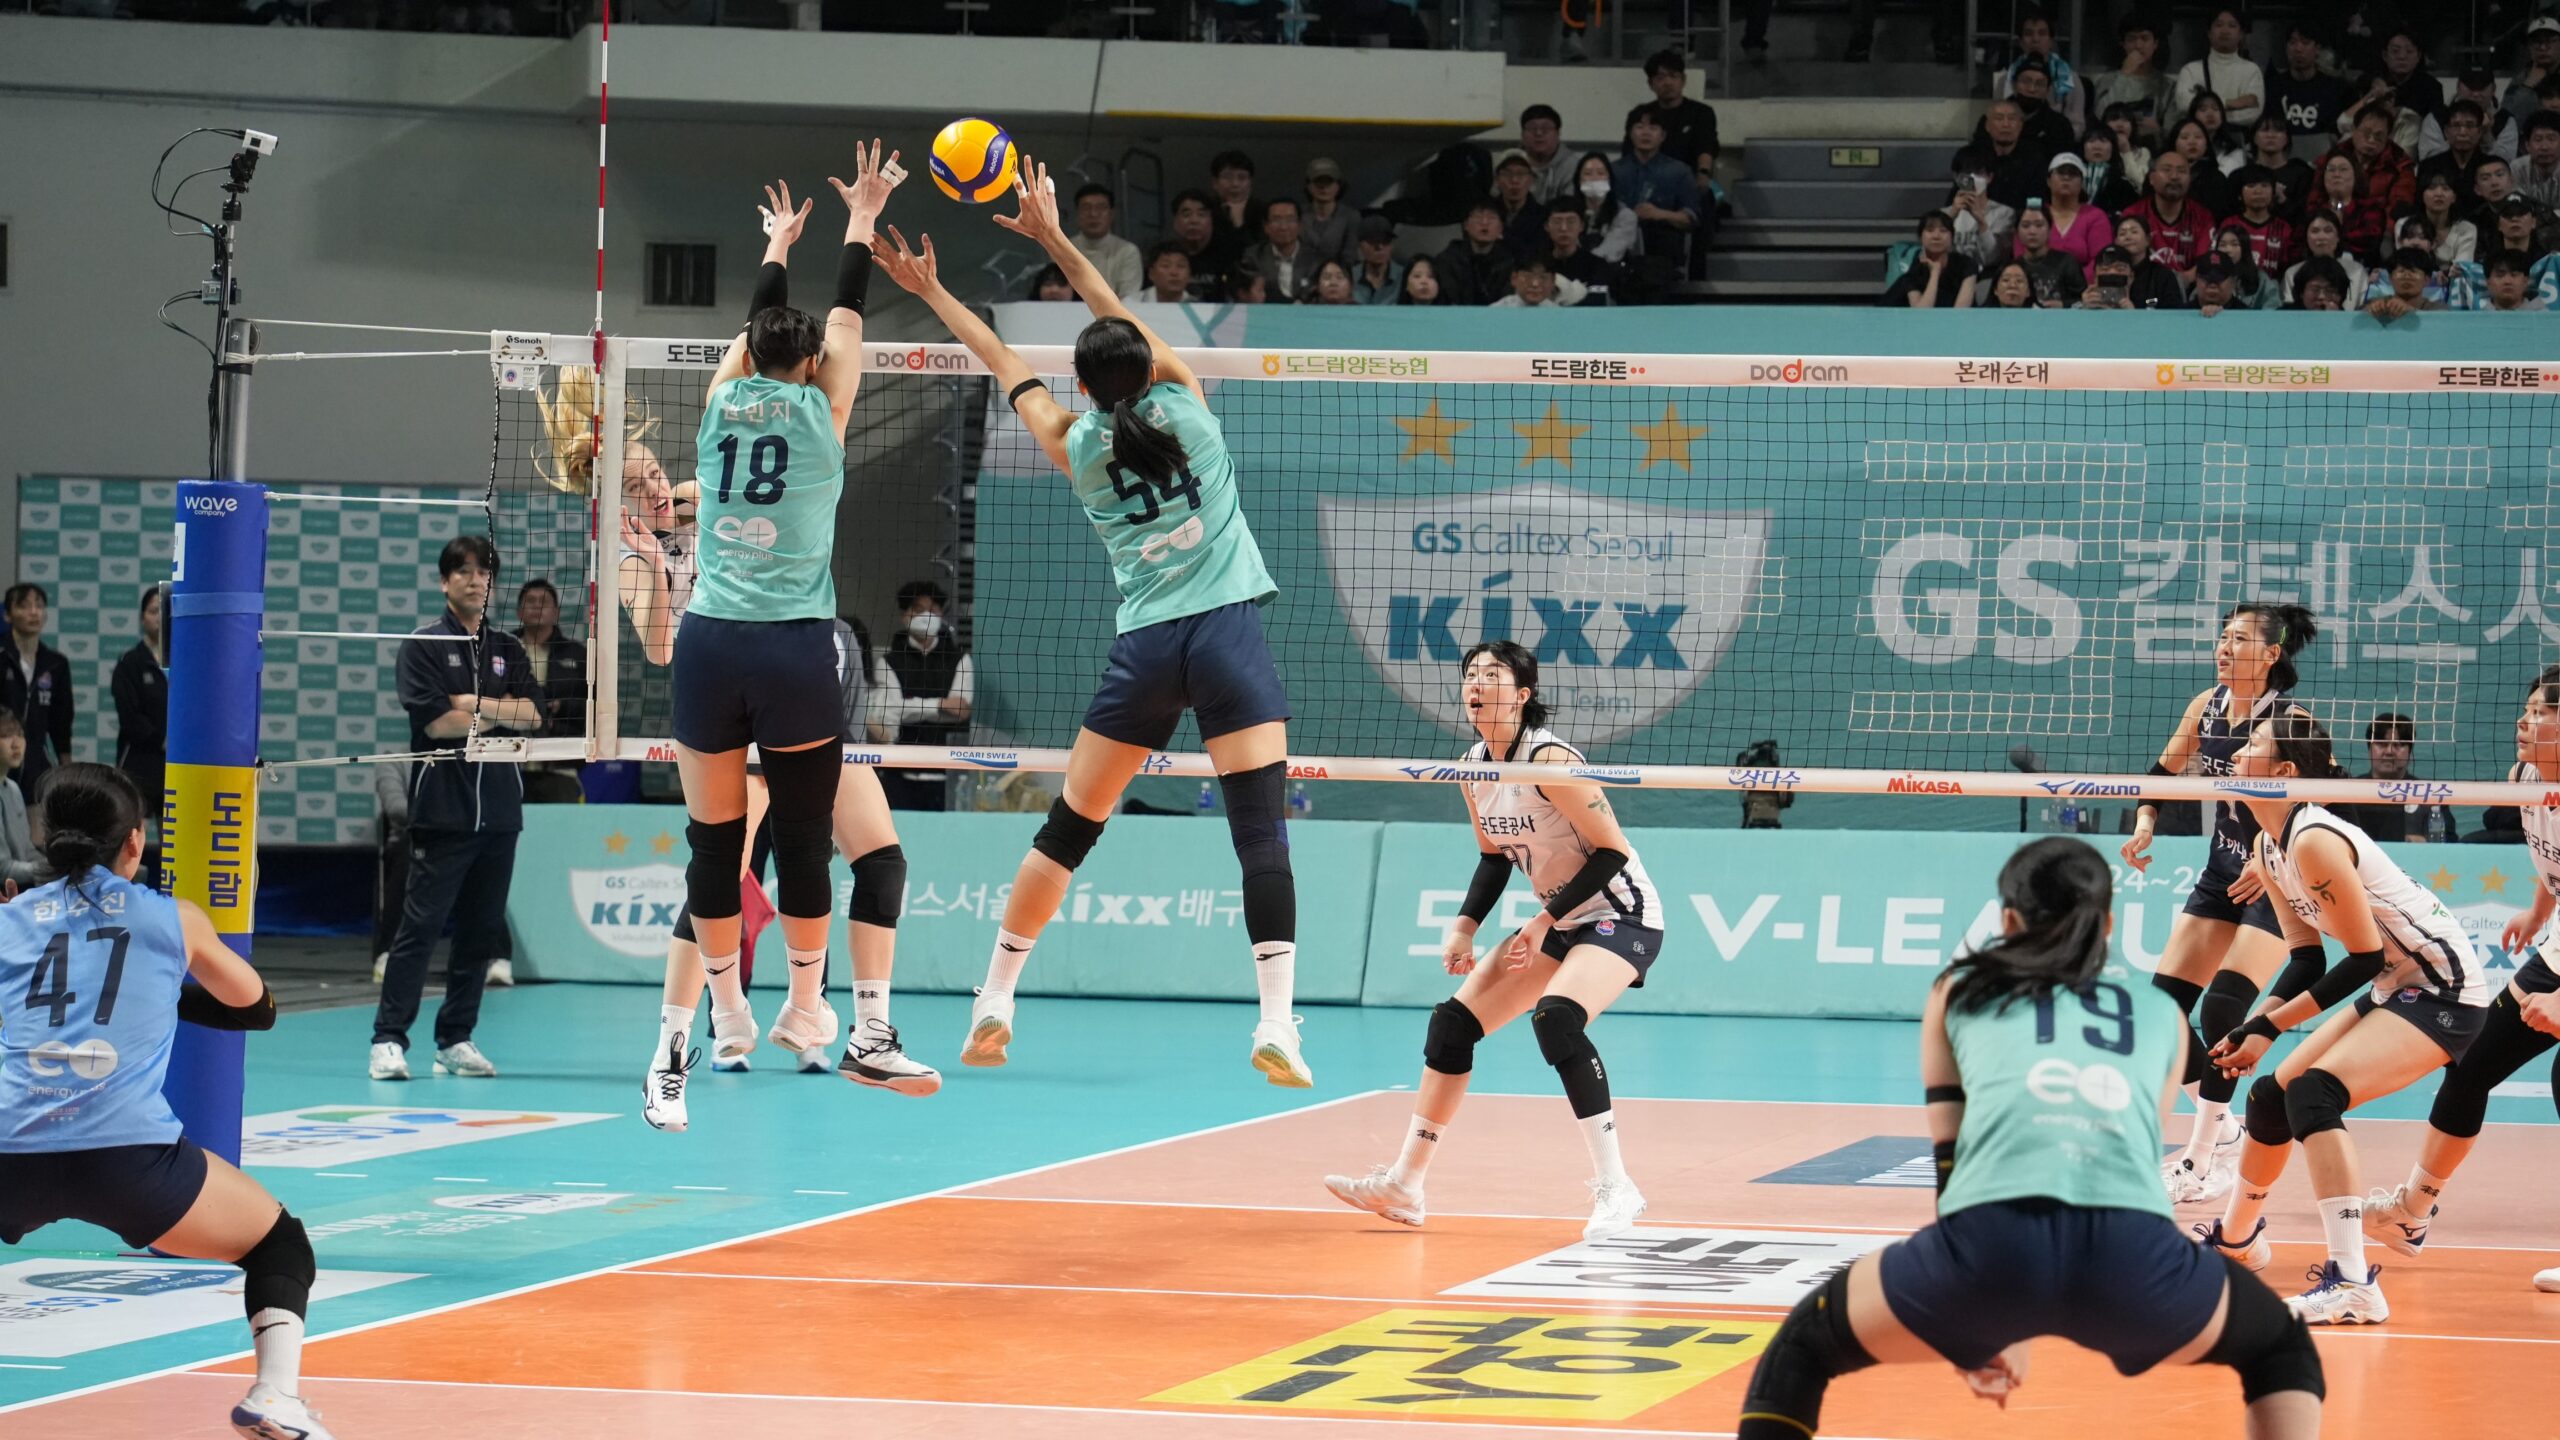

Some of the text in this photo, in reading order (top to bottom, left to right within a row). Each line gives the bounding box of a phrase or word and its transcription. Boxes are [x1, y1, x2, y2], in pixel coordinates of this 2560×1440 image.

[514, 336, 542, 344] Senoh
[667, 344, 732, 364] 도드람
[1286, 355, 1429, 376] 도드람양돈농협
[1955, 360, 2049, 385] 본래순대
[2181, 364, 2331, 385] 도드람양돈농협
[717, 433, 788, 504] 18
[1106, 458, 1202, 526] 54
[184, 496, 238, 512] wave
[194, 509, 226, 518] company
[1413, 522, 1674, 562] GS Caltex Seoul
[752, 551, 774, 560] plus
[1871, 532, 2083, 664] GS
[1567, 689, 1632, 714] Team
[949, 750, 1018, 761] POCARI SWEAT
[1286, 766, 1328, 779] KASA
[1569, 768, 1604, 776] POCARI
[1742, 770, 1801, 790] 삼다수
[2391, 783, 2453, 803] 삼다수
[209, 792, 242, 907] 도드람
[605, 877, 626, 889] GS
[34, 892, 126, 922] 한수진
[591, 895, 677, 926] Kíx
[25, 927, 131, 1027] 47
[28, 1084, 76, 1097] energy
[1233, 1316, 1752, 1405] 휴온스
